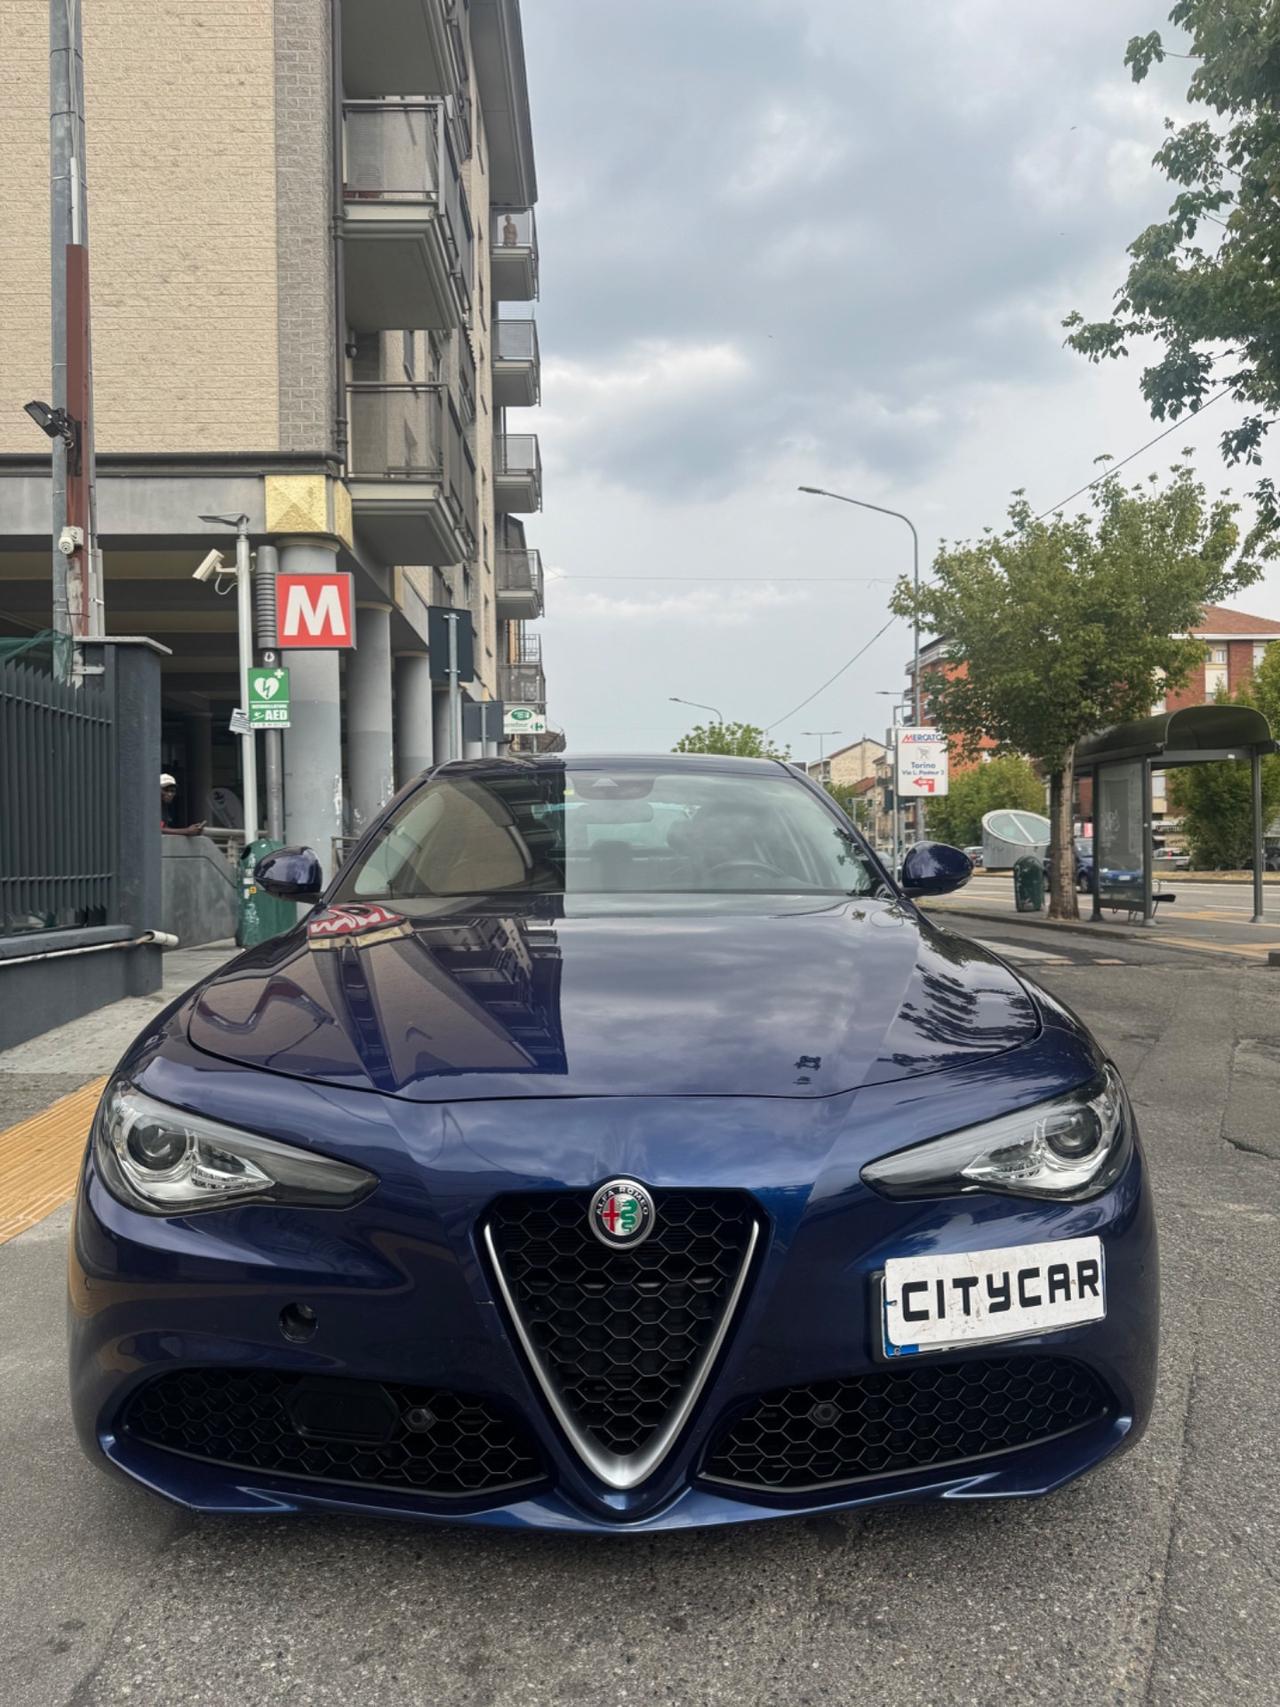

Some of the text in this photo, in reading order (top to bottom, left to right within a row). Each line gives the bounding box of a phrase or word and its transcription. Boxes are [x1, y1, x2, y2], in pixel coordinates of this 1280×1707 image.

[283, 585, 347, 636] M
[265, 710, 288, 721] AED
[911, 761, 936, 769] Torino
[596, 1186, 649, 1215] ALFA ROMEO
[901, 1259, 1100, 1322] CITYCAR
